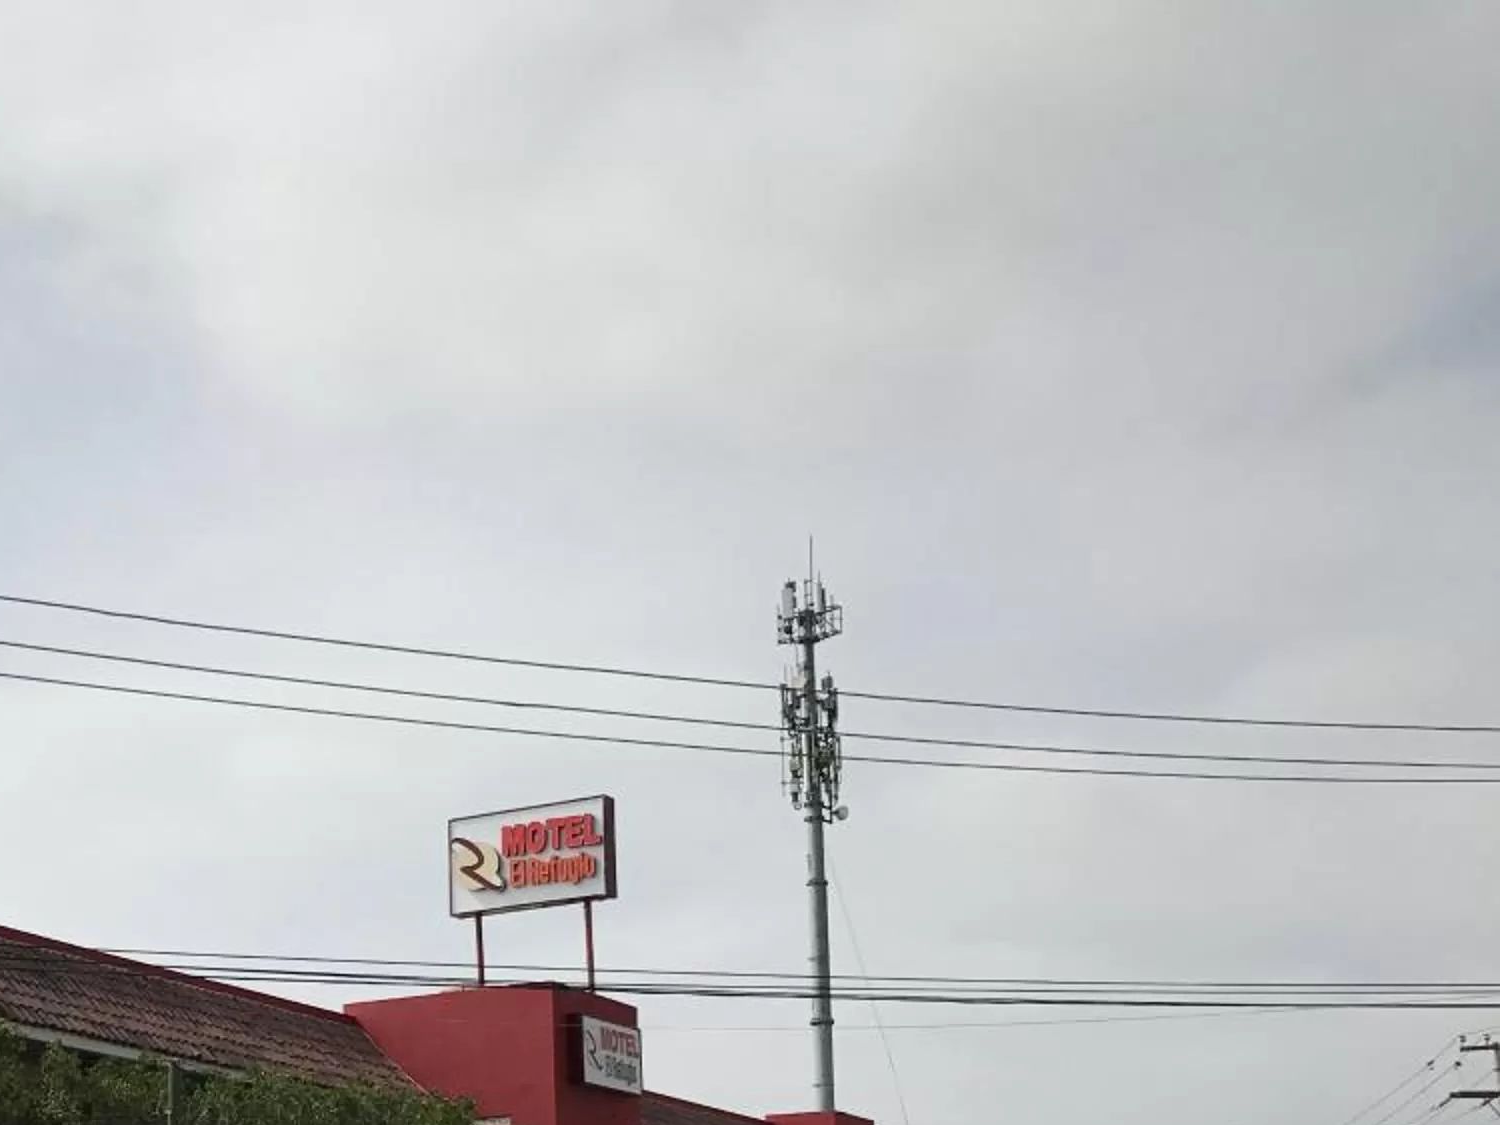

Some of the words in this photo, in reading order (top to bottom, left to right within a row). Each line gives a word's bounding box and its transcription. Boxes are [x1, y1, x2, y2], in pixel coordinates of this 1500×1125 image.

[501, 813, 603, 858] MOTEL
[510, 859, 526, 888] El
[600, 1025, 640, 1058] MOTEL
